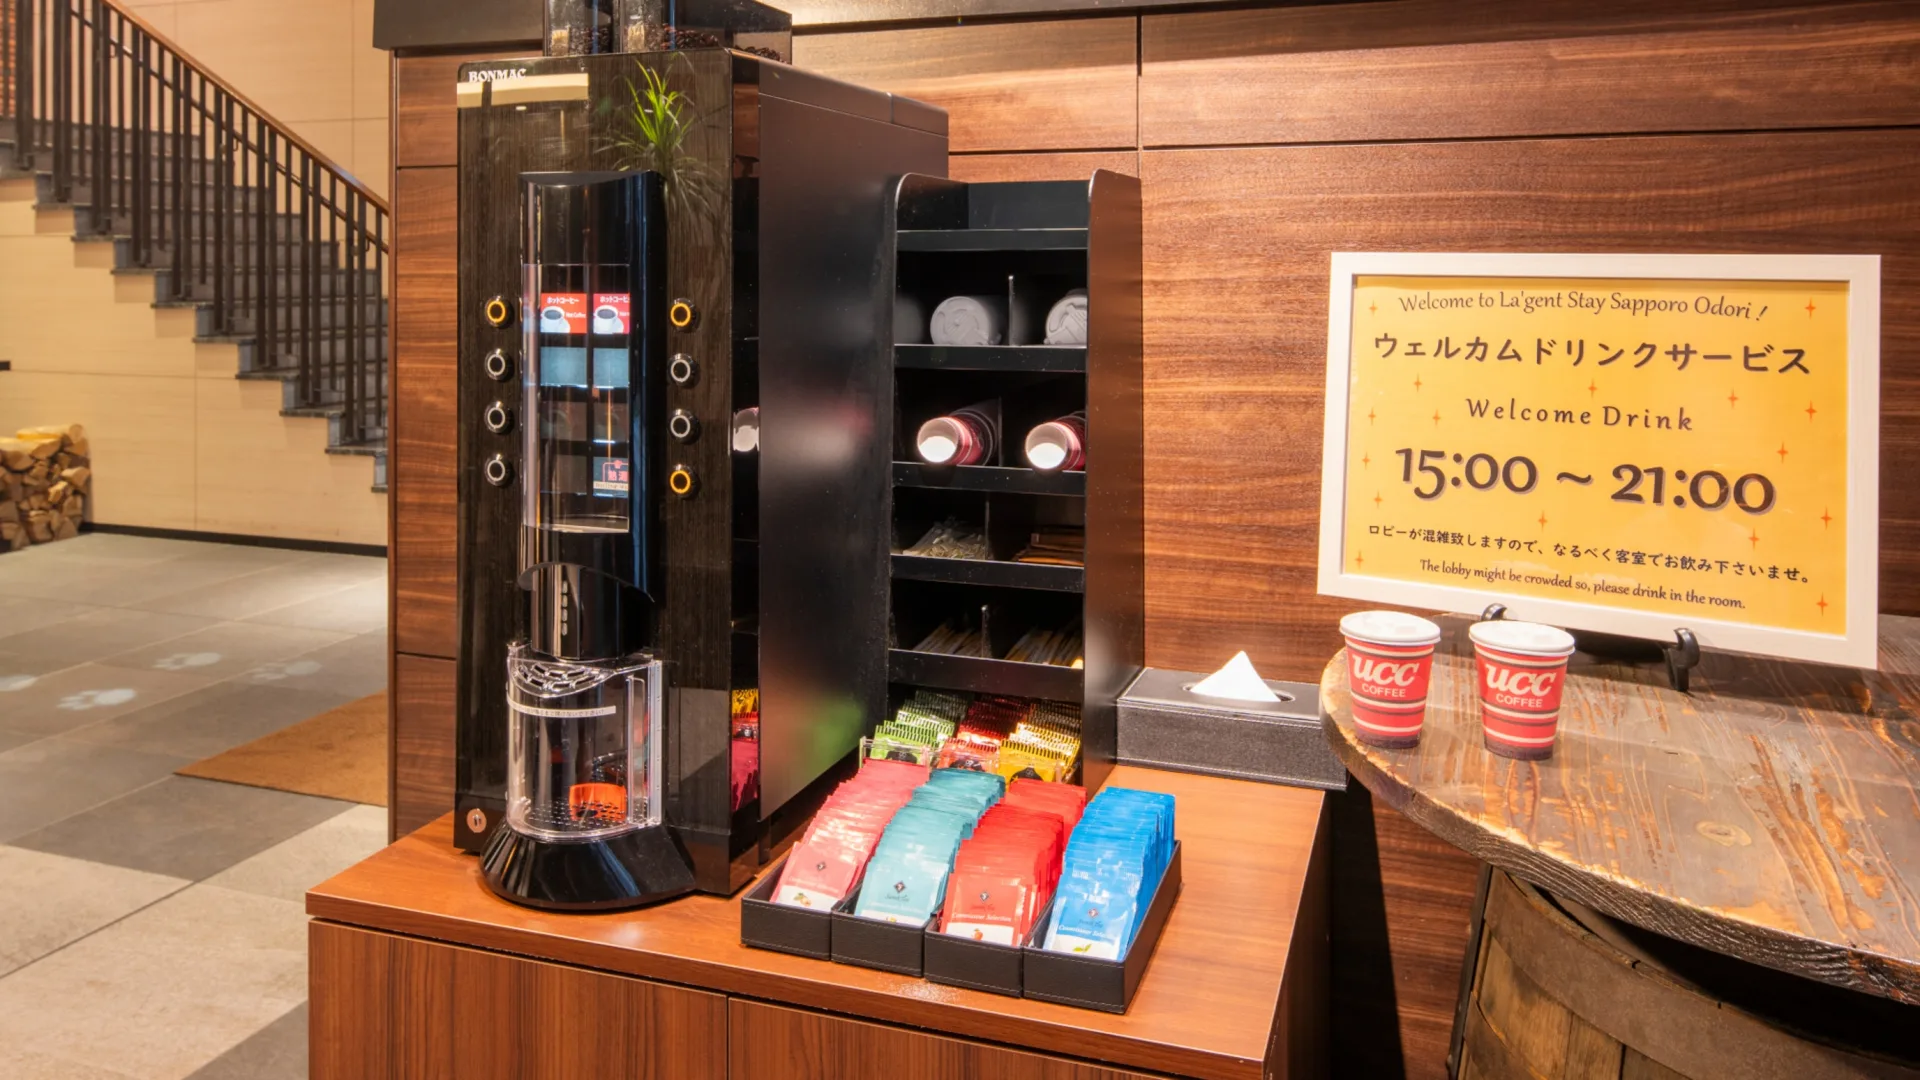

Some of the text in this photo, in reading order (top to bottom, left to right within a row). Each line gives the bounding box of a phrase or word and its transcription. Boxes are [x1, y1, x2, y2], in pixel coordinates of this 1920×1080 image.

[468, 68, 527, 82] BONMAC
[1398, 291, 1474, 312] Welcome
[1478, 292, 1495, 308] to
[1500, 290, 1563, 314] La'gent
[1567, 291, 1606, 315] Stay
[1610, 292, 1688, 316] Sapporo
[1694, 296, 1752, 319] Odori
[1373, 332, 1810, 375] ウェルカムドリンクサービス
[1466, 398, 1693, 431] Welcome Drink
[1395, 447, 1539, 501] 15:00
[1610, 463, 1777, 515] 21:00
[1419, 559, 1746, 609] The lobby might be crowded so, please drink in the room.
[1361, 682, 1406, 698] COFFEE
[1495, 693, 1543, 709] COFFEE
